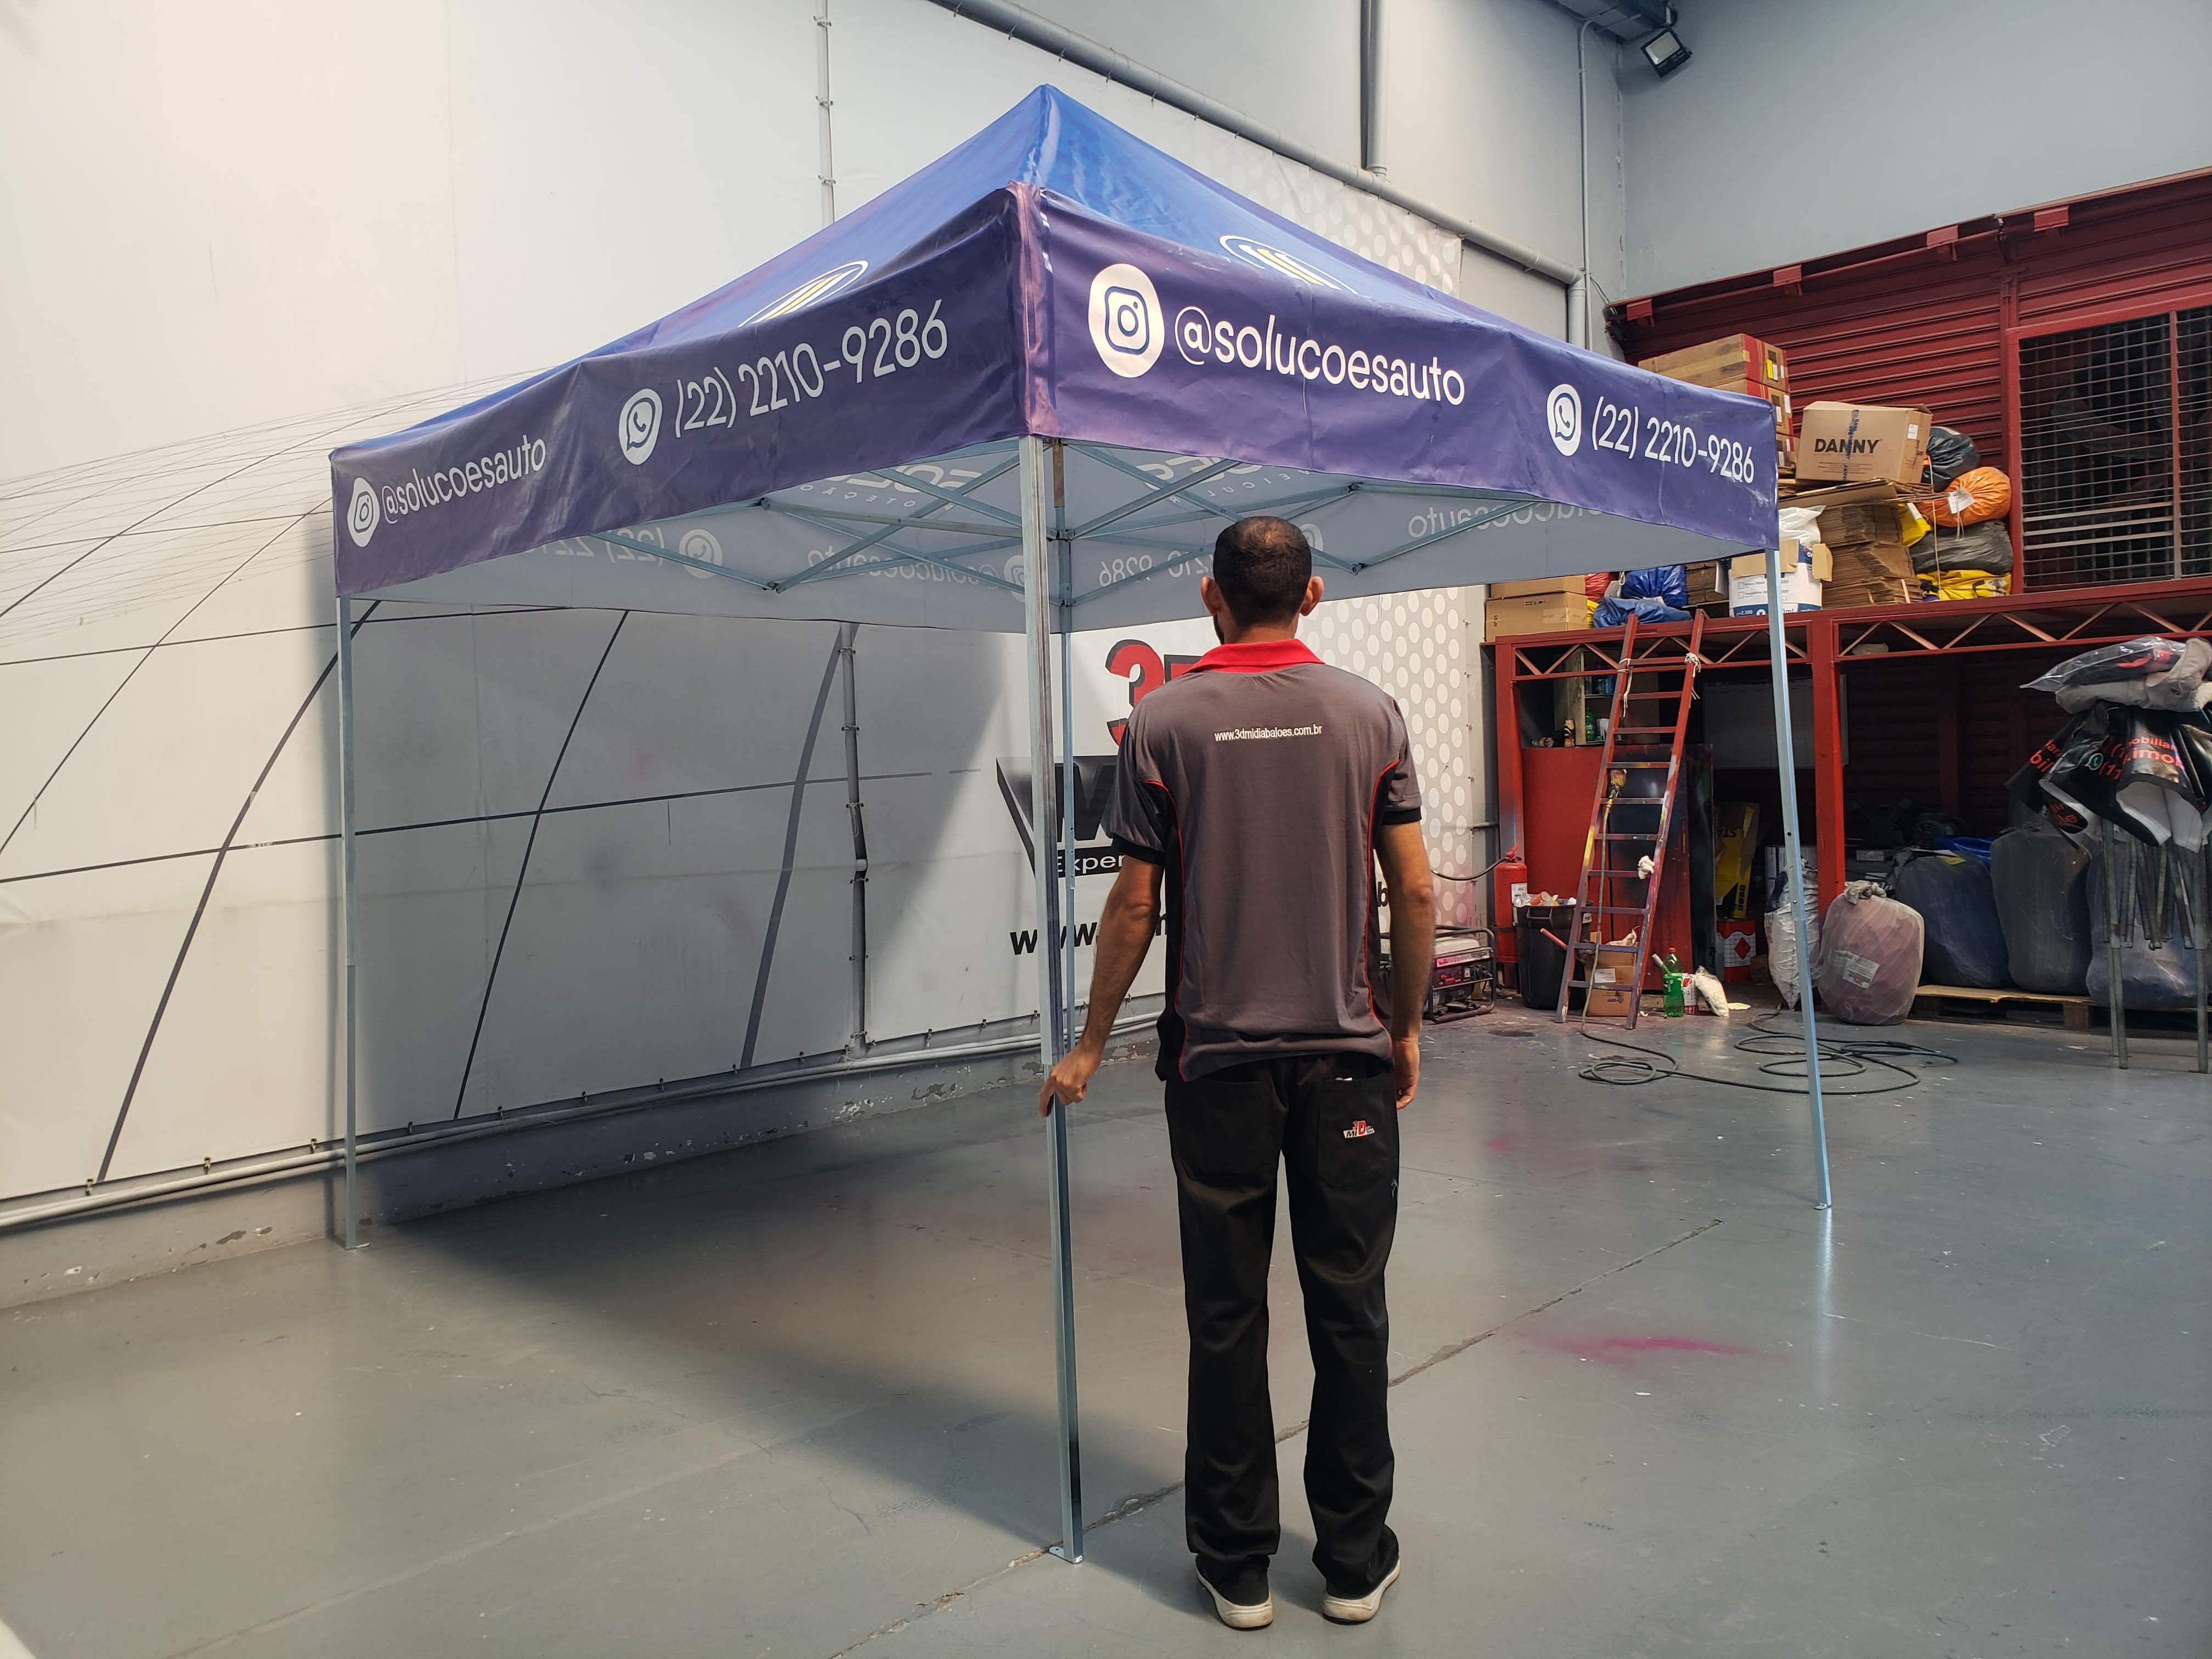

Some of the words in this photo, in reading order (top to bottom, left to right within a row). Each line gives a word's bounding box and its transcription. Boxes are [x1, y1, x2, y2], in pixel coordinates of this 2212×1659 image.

[675, 367, 736, 438] (22)
[740, 300, 948, 417] 2210-9286
[1174, 306, 1465, 405] @solucoesauto
[381, 435, 546, 523] @solucoesauto
[1591, 396, 1639, 459] (22)
[1644, 417, 1755, 483] 2210-9286
[1815, 438, 1879, 454] DANNY
[1214, 723, 1323, 741] www.3dmidiabaloes.com.br
